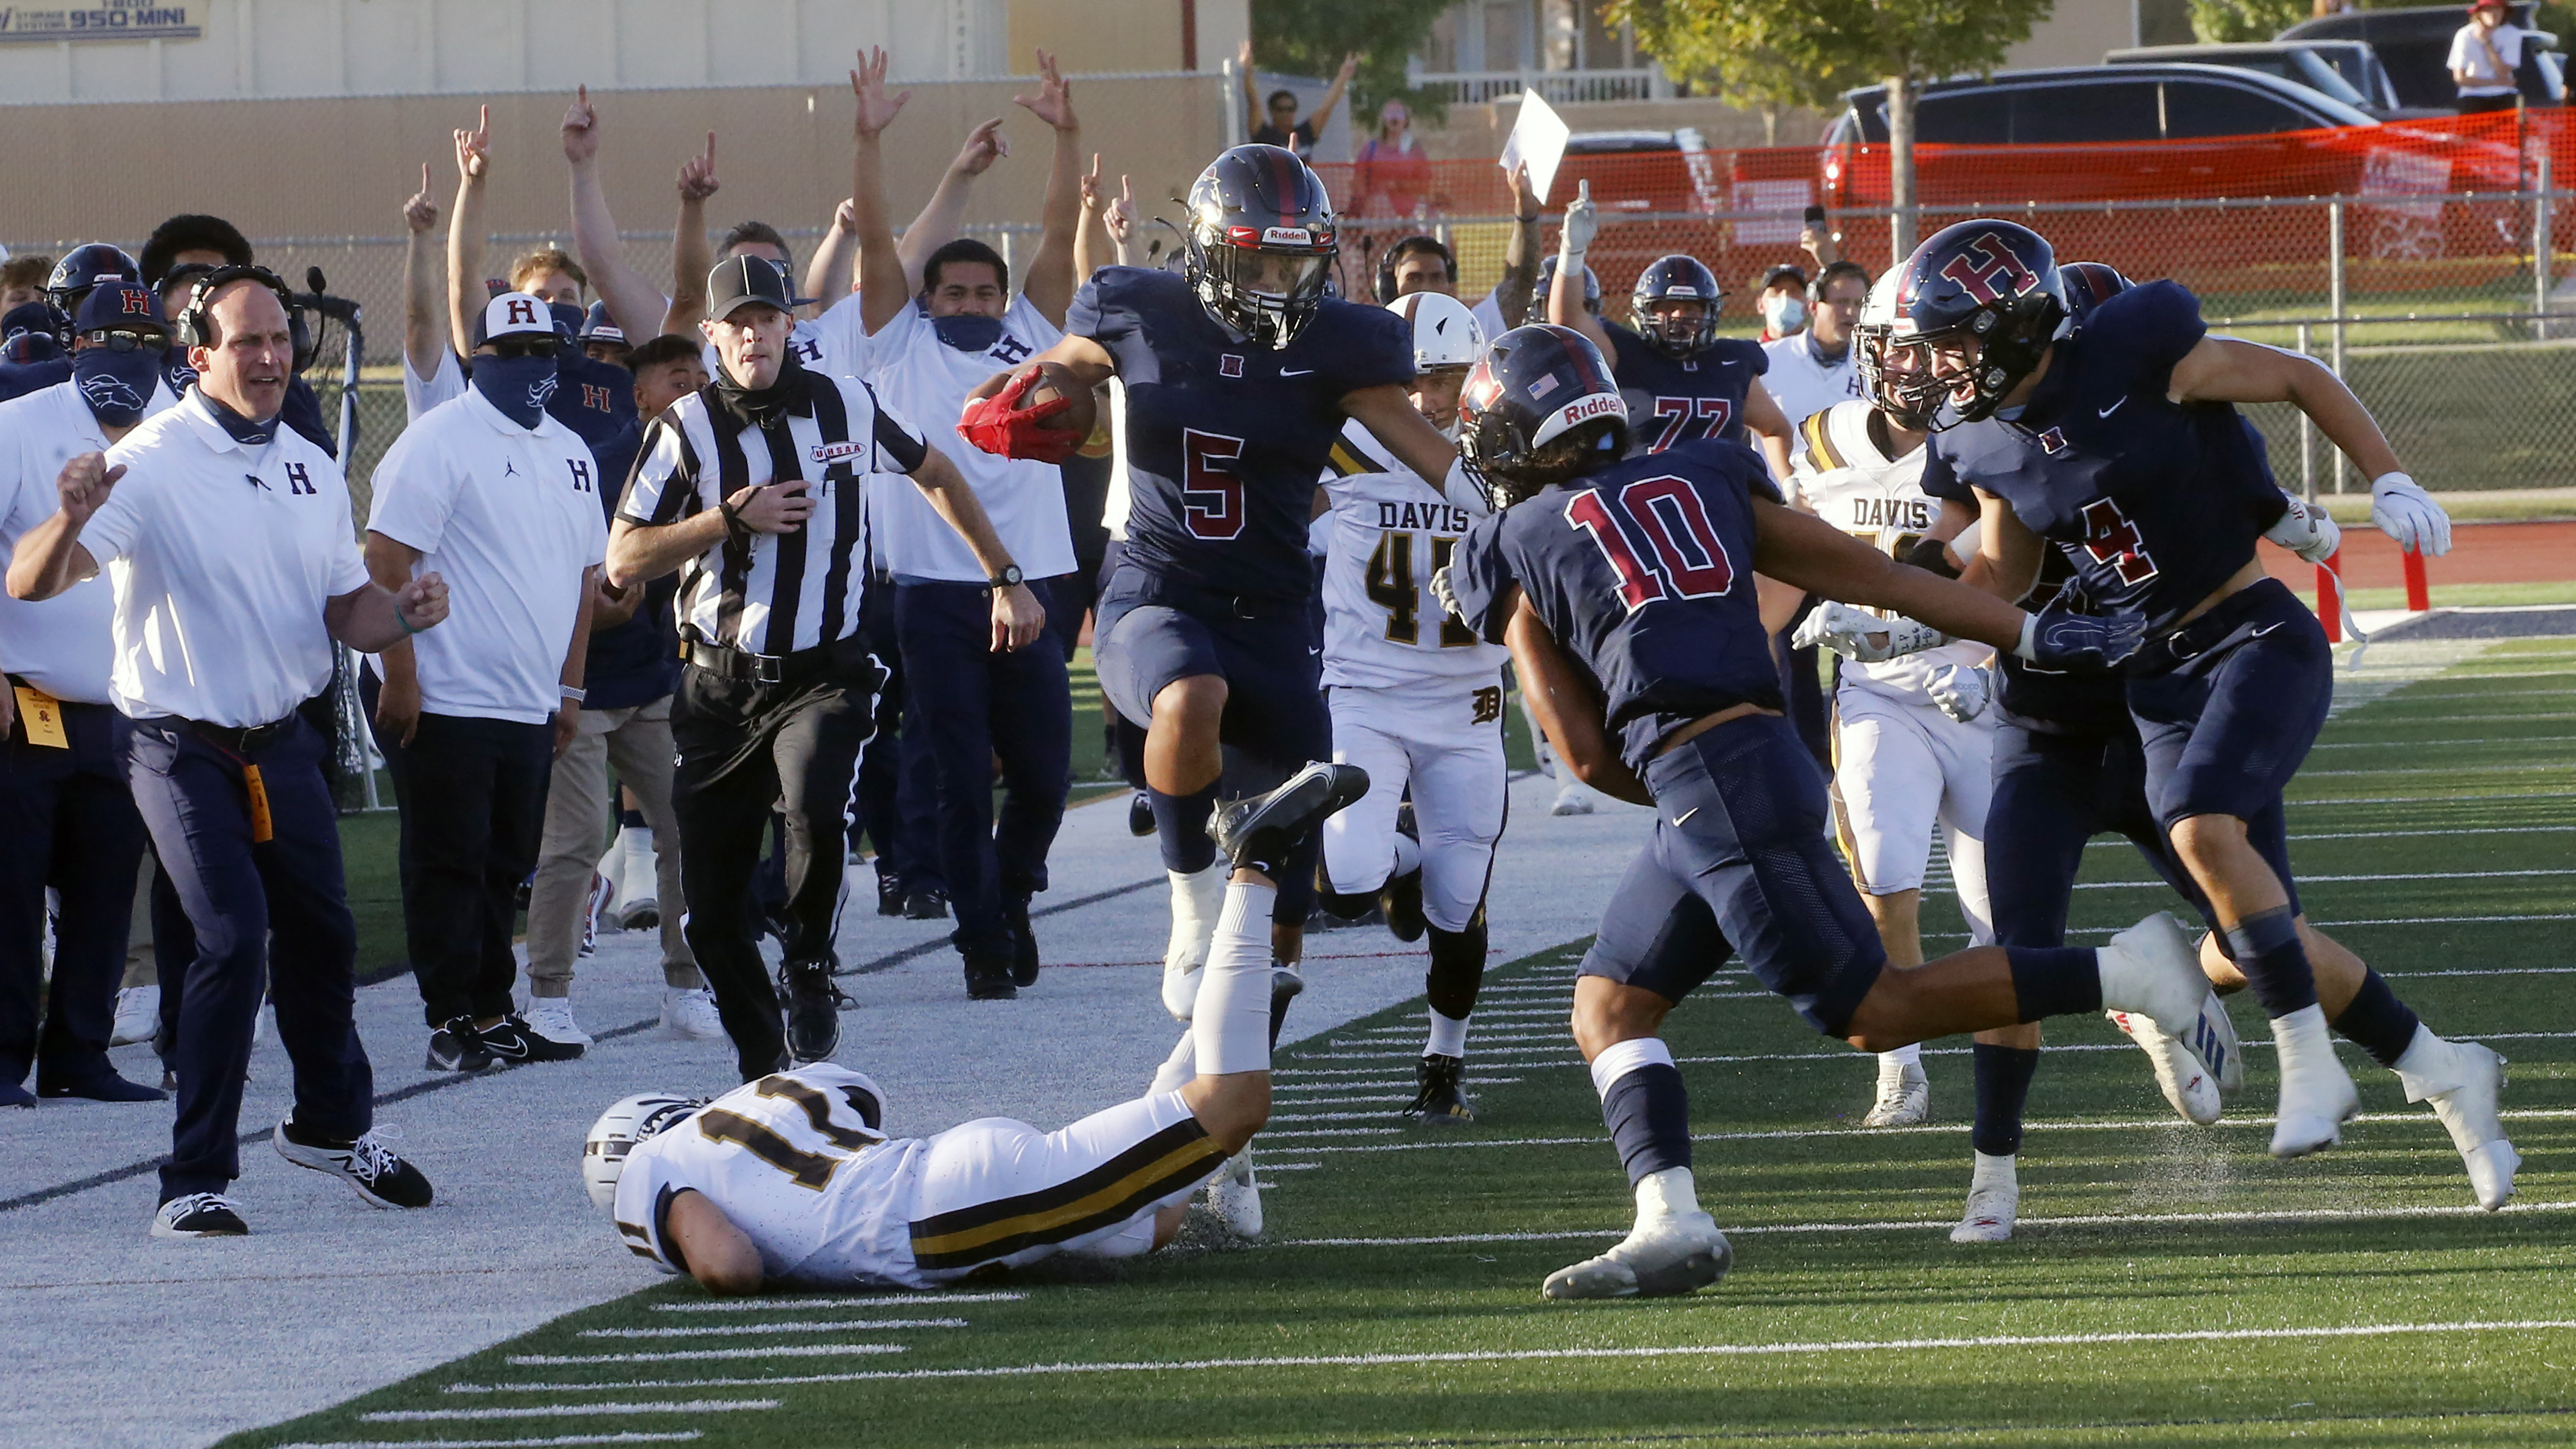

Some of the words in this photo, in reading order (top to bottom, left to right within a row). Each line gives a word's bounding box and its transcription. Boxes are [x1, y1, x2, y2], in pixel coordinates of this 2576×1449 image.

[70, 7, 185, 27] 950-MINI
[1271, 230, 1307, 240] Riddell
[1940, 232, 2040, 305] H
[120, 289, 150, 316] H
[508, 300, 537, 324] H
[989, 335, 1032, 365] H
[582, 384, 611, 413] H
[1564, 397, 1625, 425] Riddell
[1647, 396, 1731, 455] 77
[816, 445, 861, 458] UHSAA
[284, 462, 317, 494] H
[566, 459, 591, 492] H
[1184, 427, 1245, 540] 5
[1378, 502, 1468, 532] DAVIS
[1853, 498, 1928, 528] DAVIS
[1563, 475, 1734, 616] 10
[2081, 496, 2159, 587] 4
[1471, 685, 1501, 725] D
[697, 1075, 887, 1192] 11
